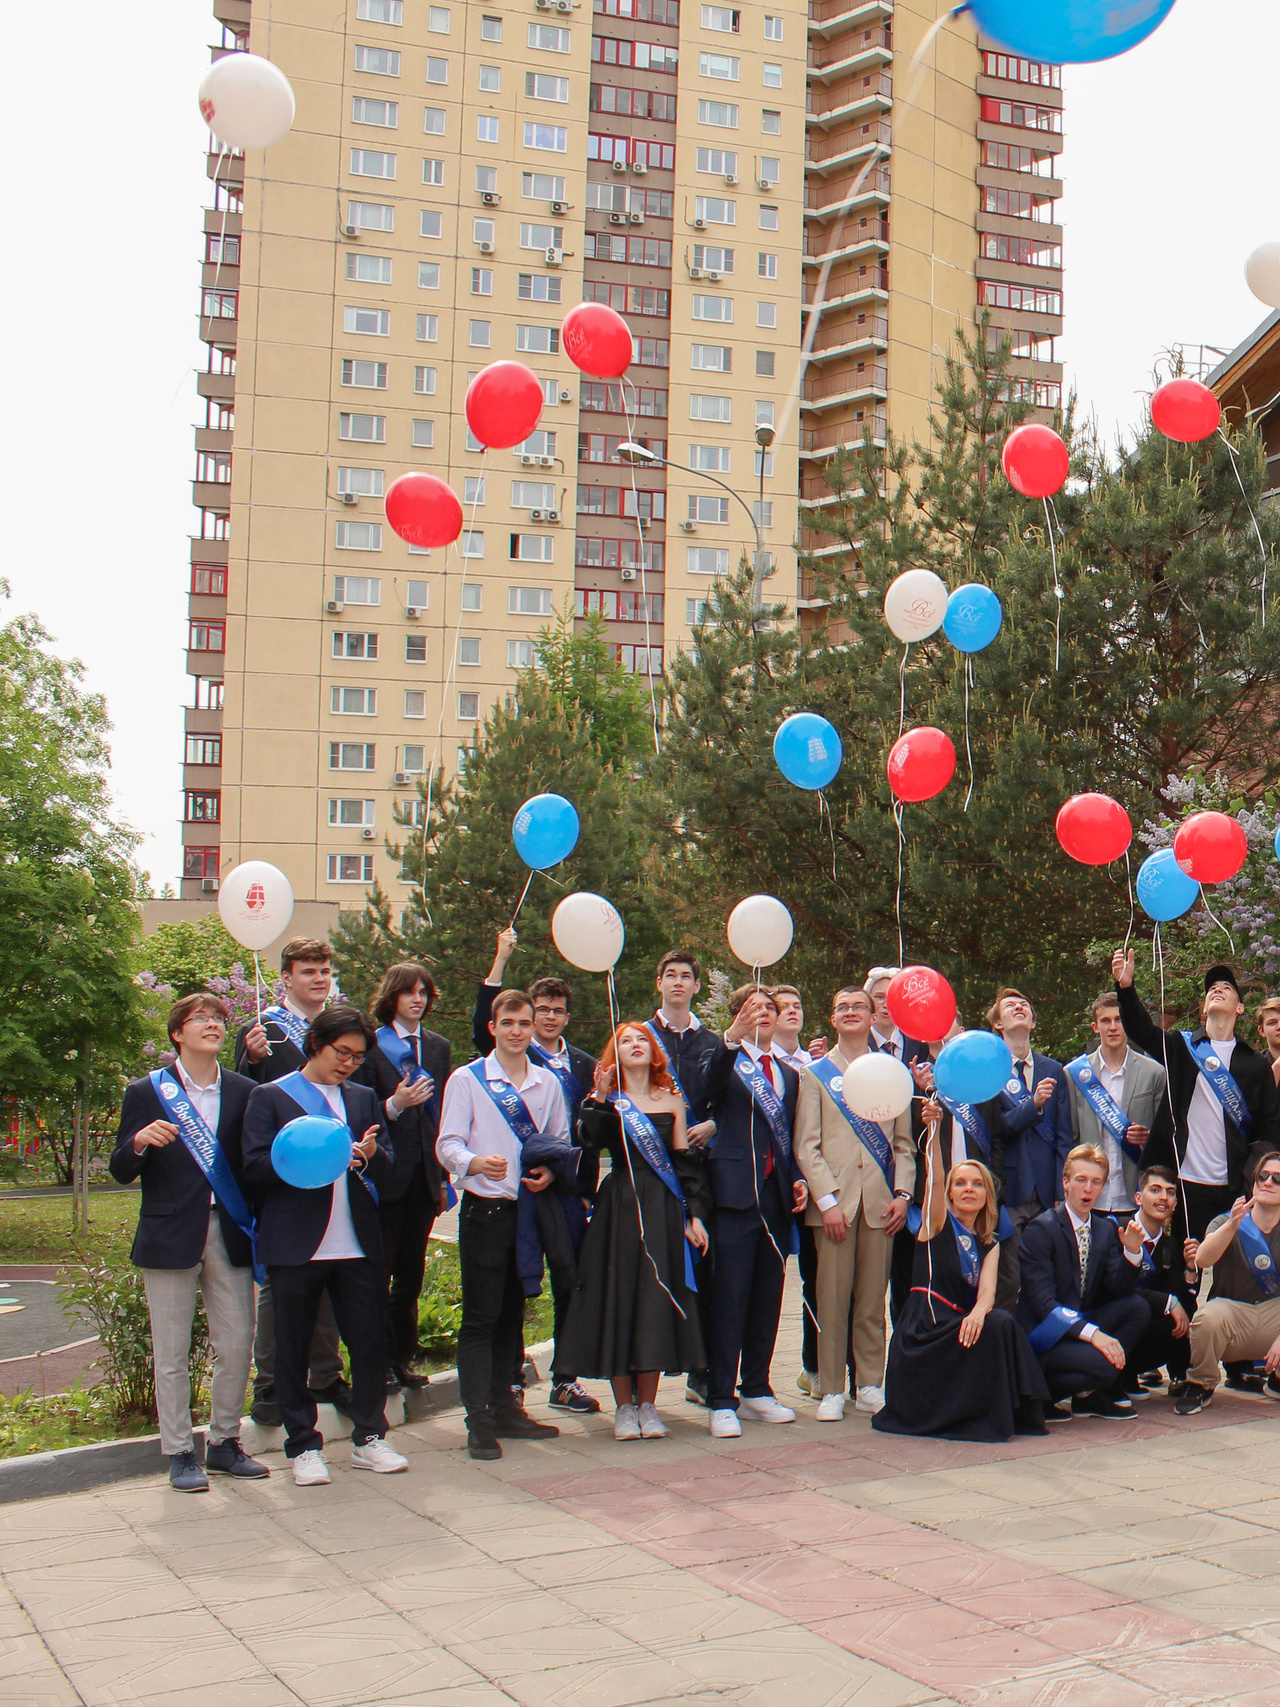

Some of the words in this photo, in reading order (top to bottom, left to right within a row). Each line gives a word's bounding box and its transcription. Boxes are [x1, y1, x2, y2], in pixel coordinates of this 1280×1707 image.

[904, 599, 937, 618] Всё
[952, 604, 983, 621] Всё
[1139, 867, 1164, 887] Всё
[902, 974, 930, 1000] Всё
[750, 1076, 785, 1135] Выпускник
[625, 1111, 662, 1167] Выпускница
